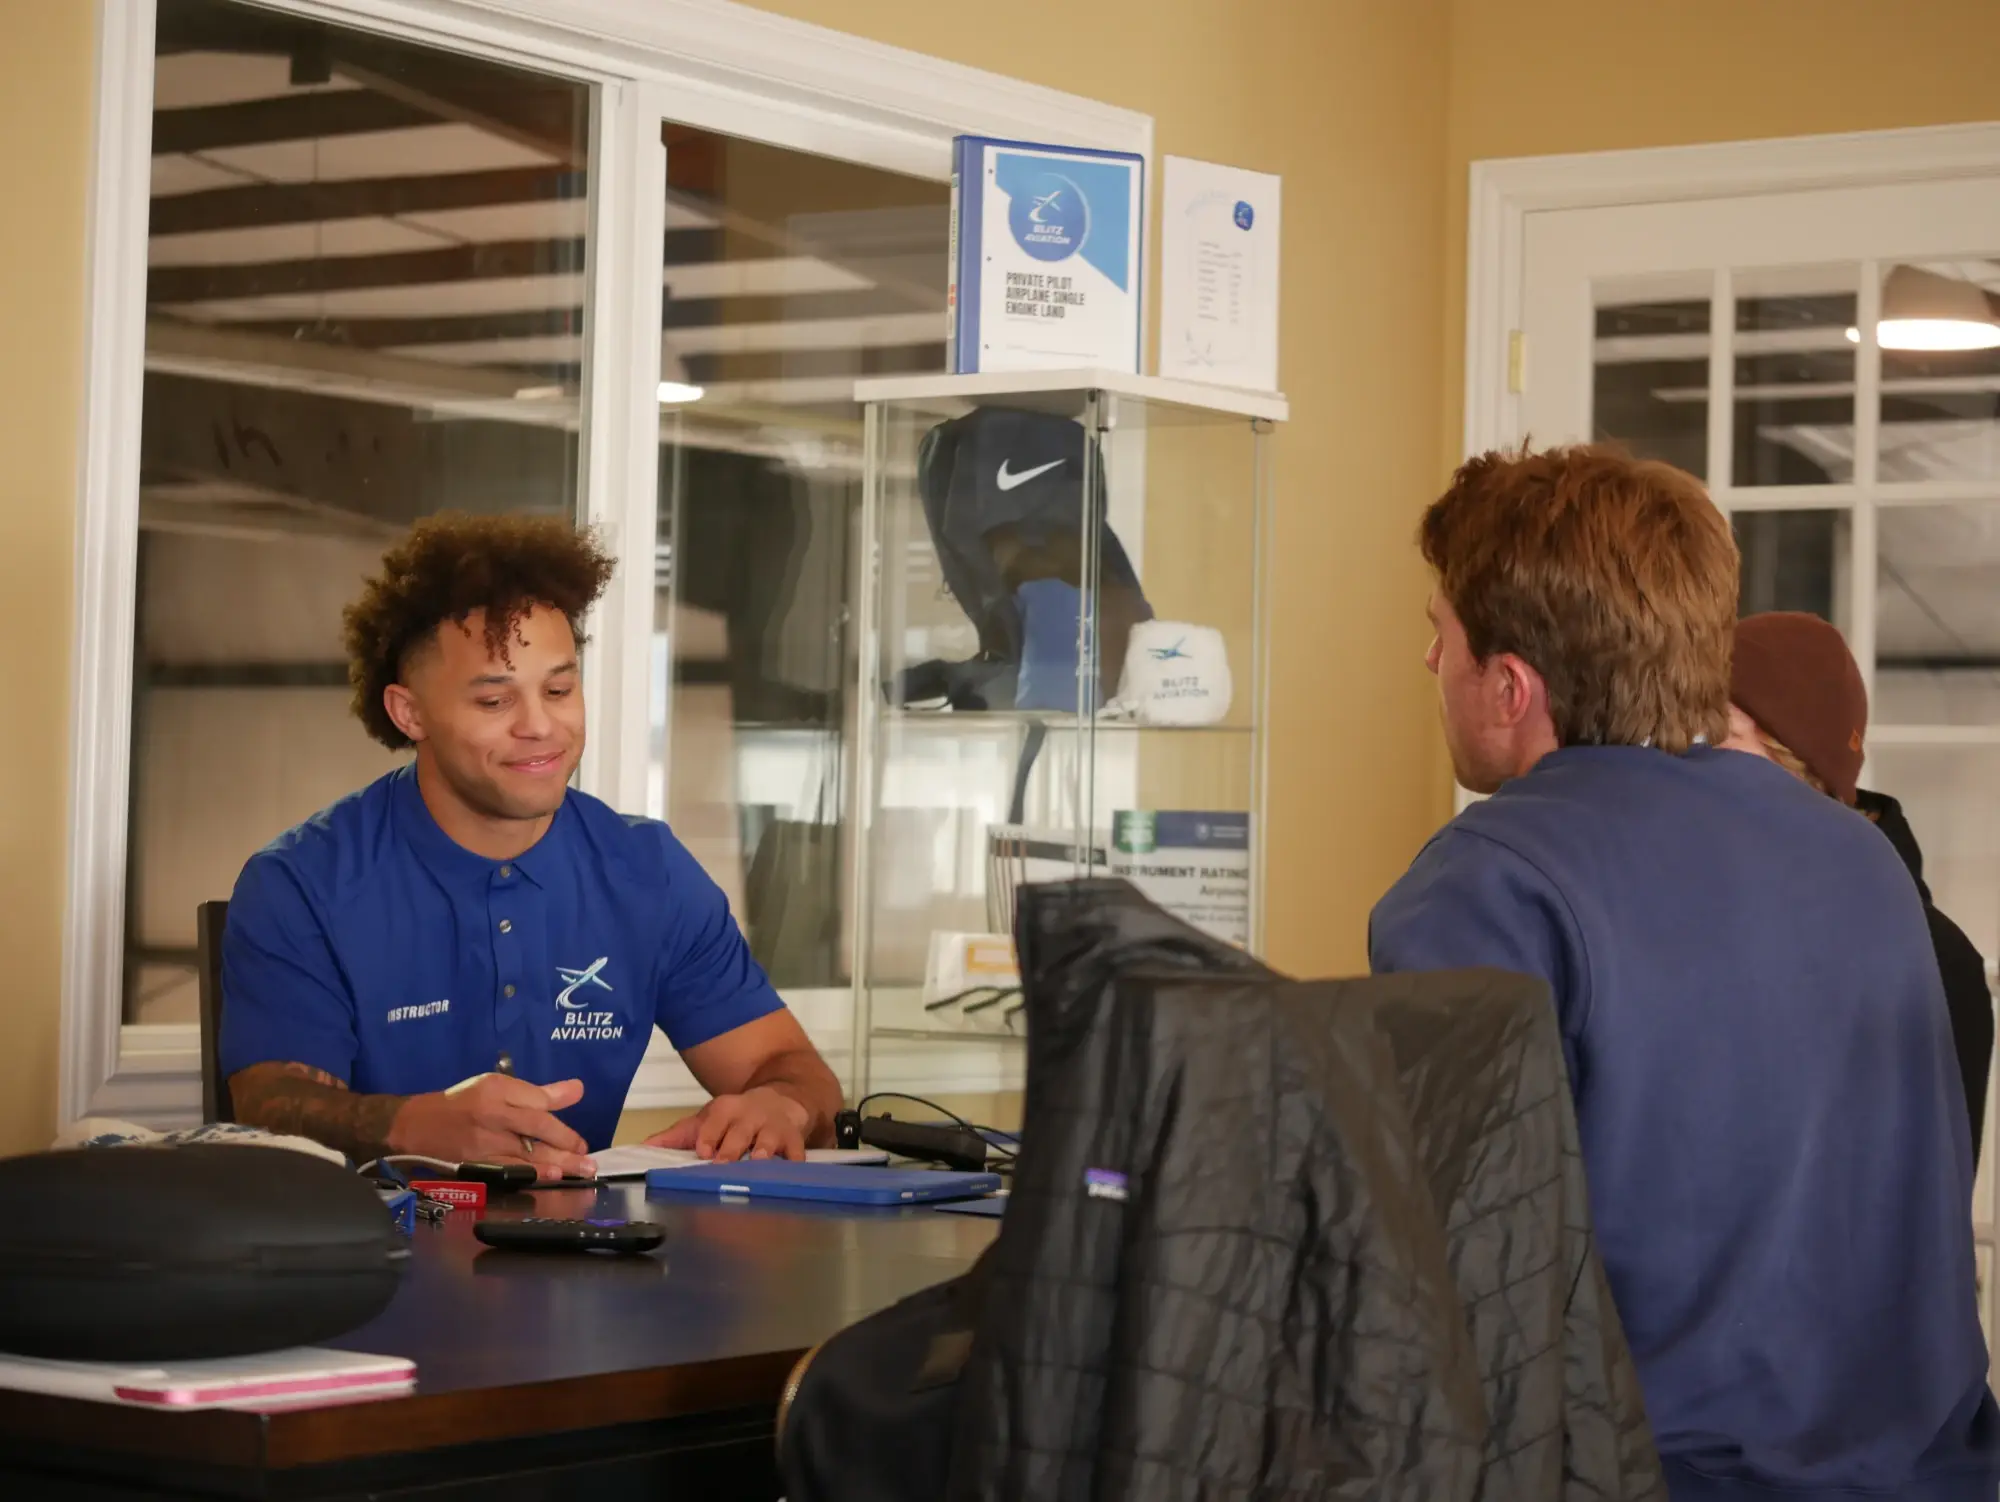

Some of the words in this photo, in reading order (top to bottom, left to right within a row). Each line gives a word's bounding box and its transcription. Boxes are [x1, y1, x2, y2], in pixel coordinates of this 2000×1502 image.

[1033, 224, 1064, 234] BLITZ
[1024, 233, 1071, 244] AVIATION
[1006, 272, 1044, 288] PRIVATE
[1047, 276, 1072, 290] PILOT
[1006, 286, 1049, 303] AIRPLANE
[1053, 291, 1085, 306] SINGLE
[1006, 301, 1038, 316] ENGINE
[1041, 305, 1065, 319] LAND
[1162, 676, 1199, 688] BLITZ
[1153, 688, 1210, 700] AVIATION
[388, 999, 450, 1023] INSTRUCTOR
[564, 1012, 614, 1026] BLITZ
[551, 1025, 623, 1040] AVIATION
